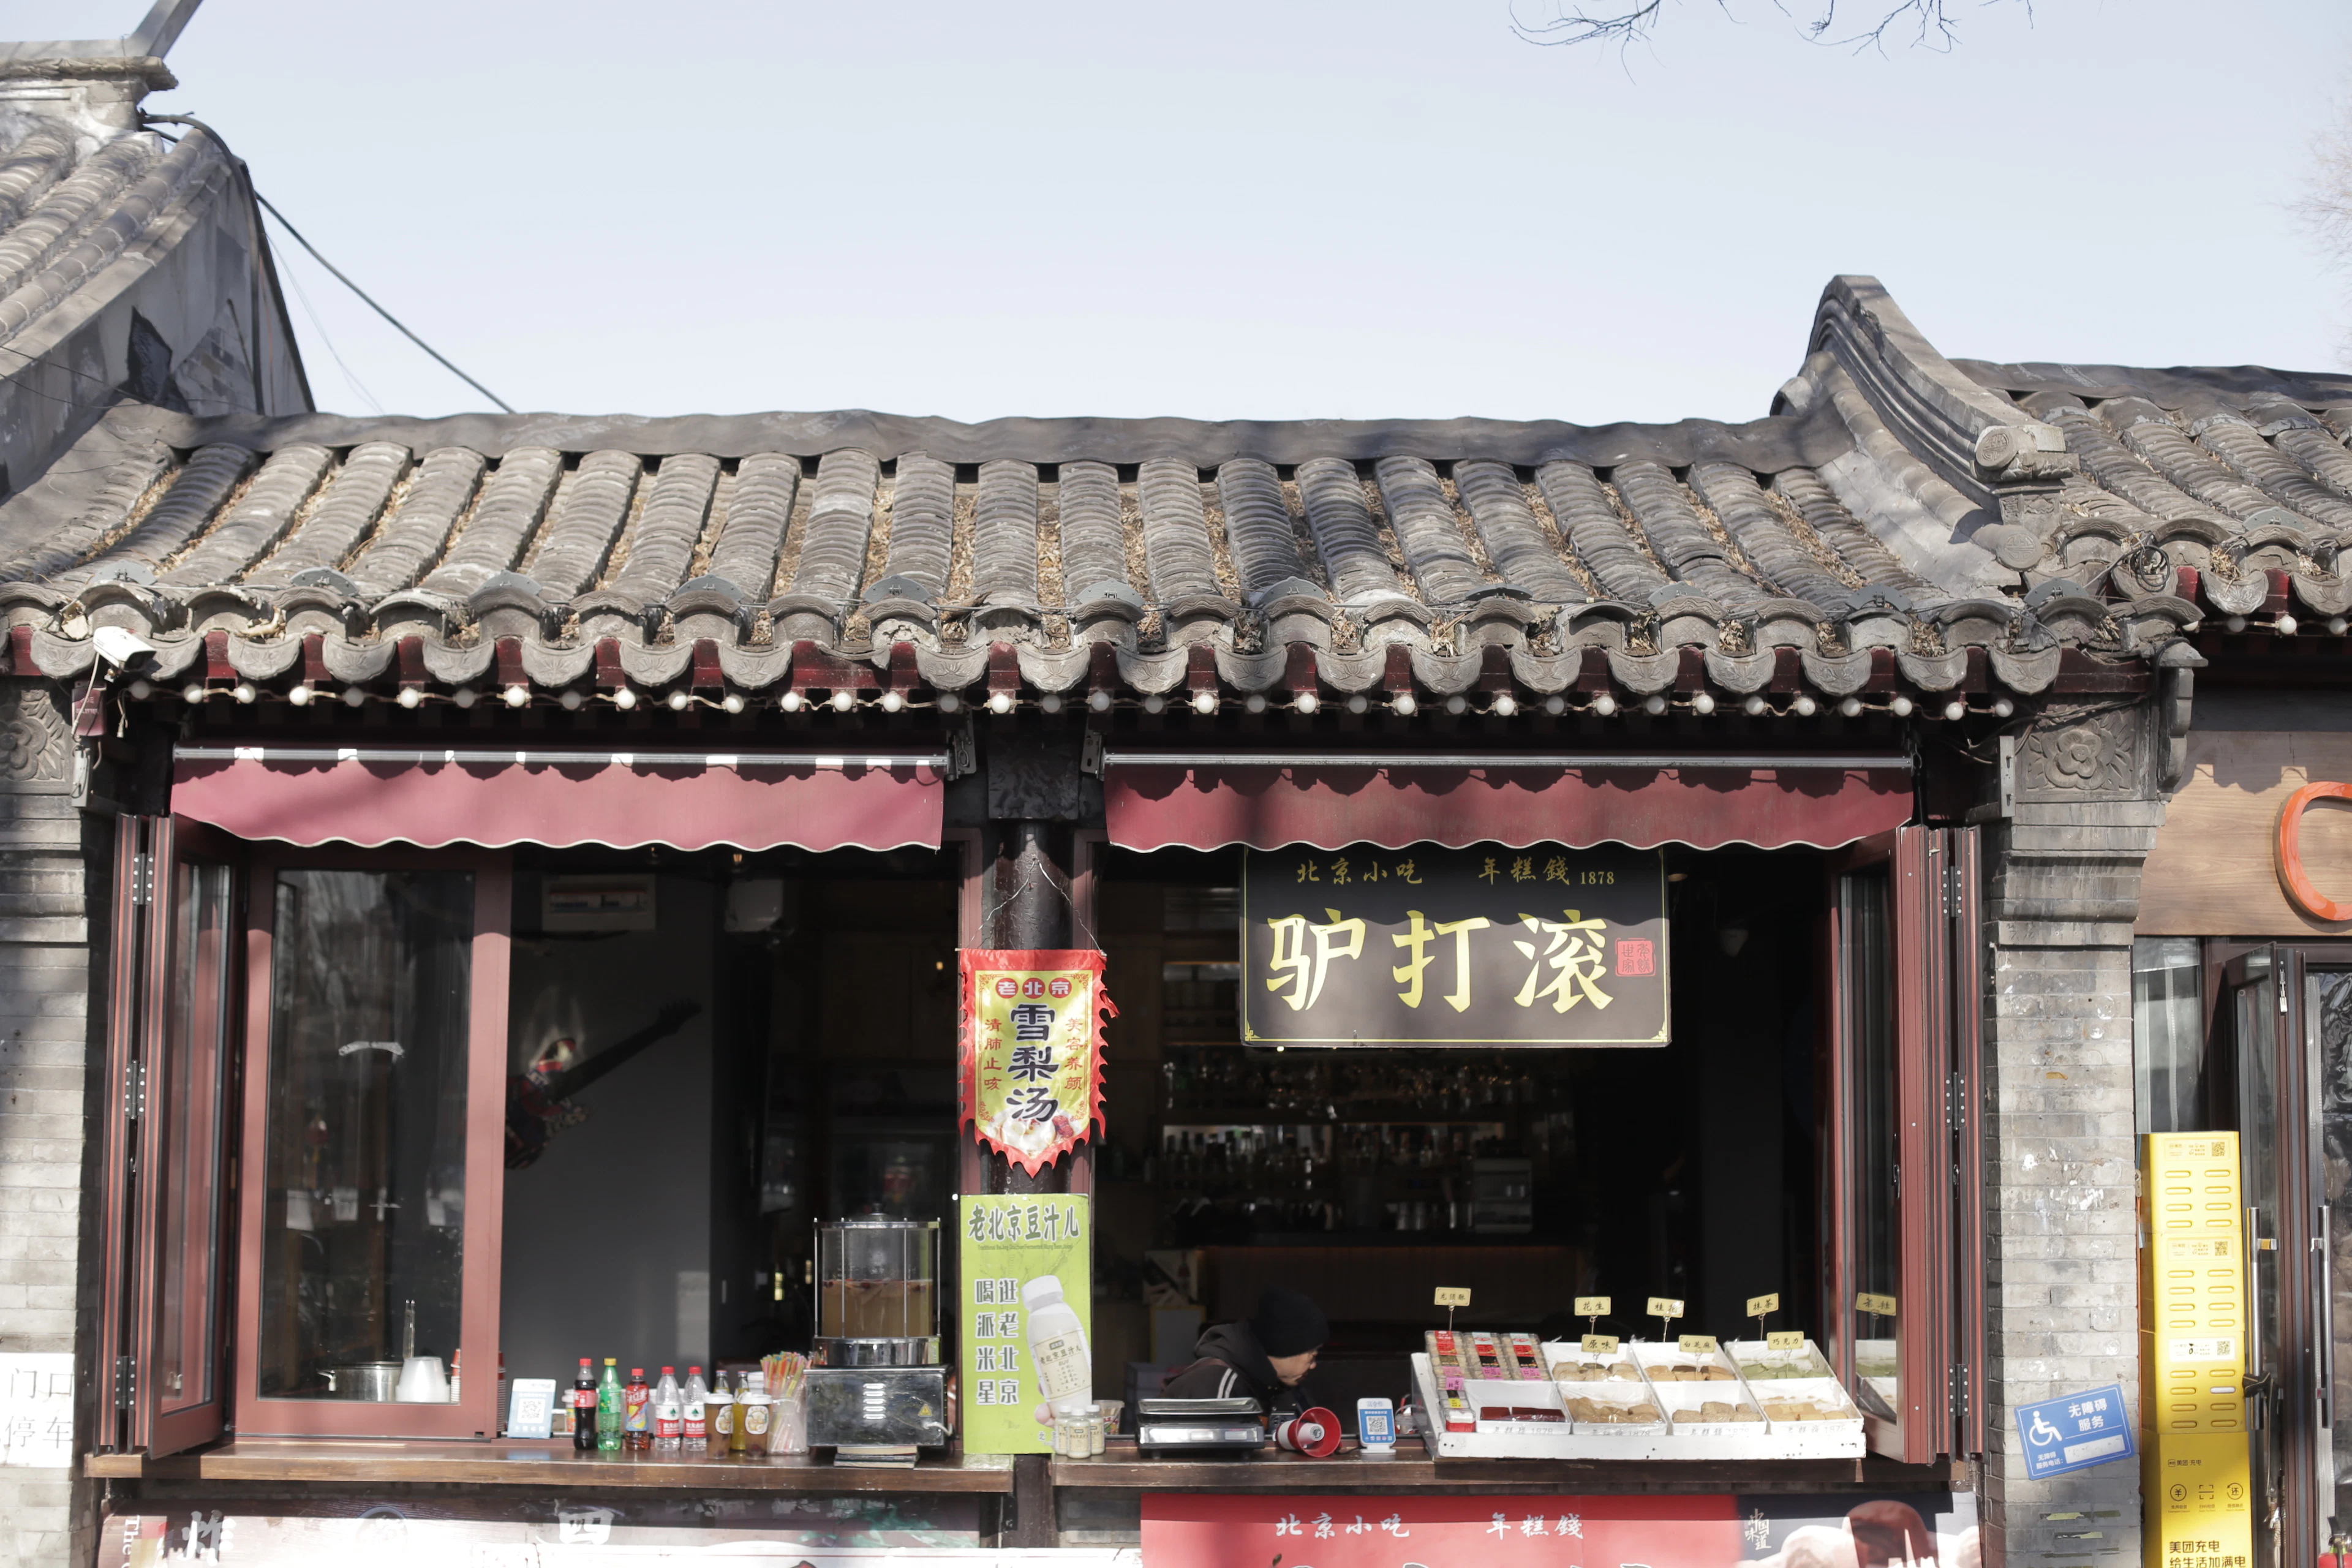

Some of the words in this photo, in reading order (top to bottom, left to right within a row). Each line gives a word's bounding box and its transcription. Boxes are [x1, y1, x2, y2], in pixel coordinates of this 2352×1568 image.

[1297, 858, 1423, 885] 北京小吃
[1478, 856, 1570, 886] 年糕錢
[1580, 871, 1615, 885] 1878
[1266, 908, 1614, 1014] 驴打滚
[998, 981, 1070, 995] 老北京
[984, 1018, 1003, 1091] 清肺止咳
[1006, 1003, 1060, 1122] 雪梨汤
[1065, 1018, 1083, 1090] 美容养颜
[968, 1203, 1080, 1242] 老北京豆汁儿
[1583, 1302, 1604, 1311] 花生
[1753, 1298, 1773, 1310] 抹茶
[974, 1278, 996, 1405] 喝派米星
[998, 1279, 1019, 1405] 逛老北京
[1588, 1340, 1611, 1349] 原味
[10, 1368, 74, 1399] 门口
[2068, 1398, 2108, 1418] 无障碍
[2078, 1415, 2104, 1431] 服务
[5, 1415, 73, 1449] 停车
[2038, 1452, 2056, 1461] 无障碍
[123, 1515, 140, 1555] The
[1276, 1512, 1410, 1539] 北京小吃
[1486, 1512, 1583, 1540] 年糕錢
[2169, 1540, 2220, 1553] 美团充电
[2169, 1556, 2247, 1568] 给生活加满电
